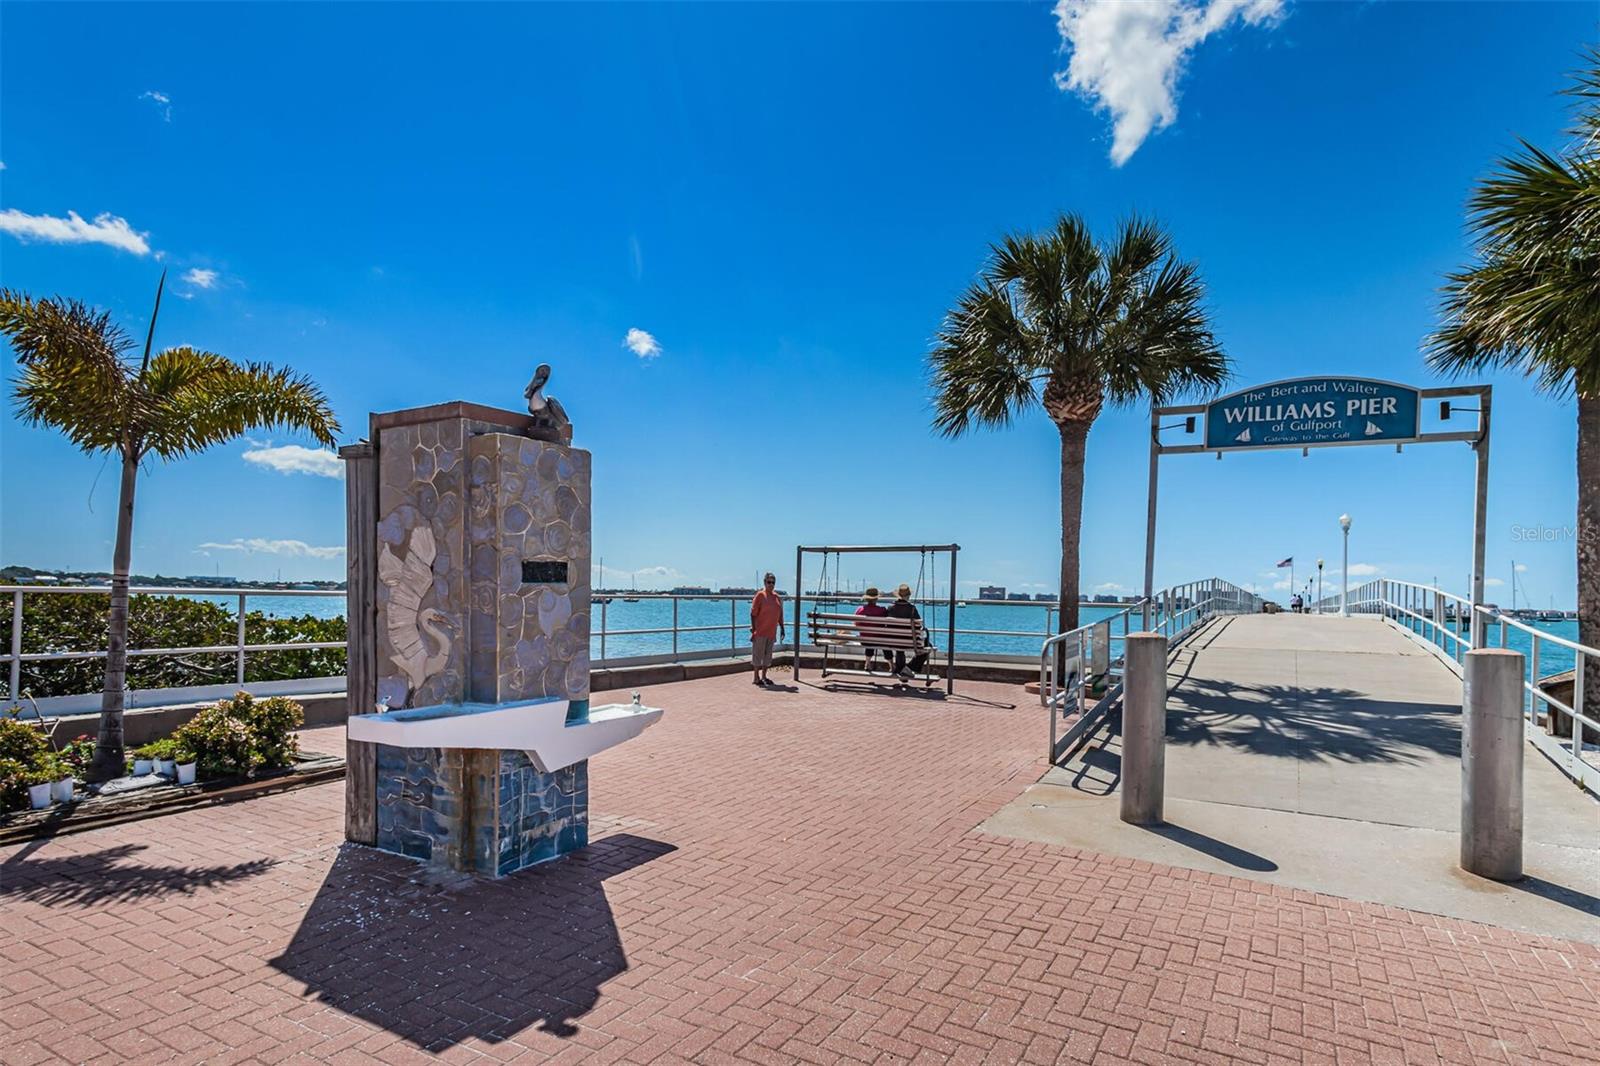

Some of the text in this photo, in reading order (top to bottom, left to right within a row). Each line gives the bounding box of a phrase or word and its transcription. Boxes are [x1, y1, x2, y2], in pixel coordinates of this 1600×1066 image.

[1244, 382, 1379, 403] The Bert and Walter
[1224, 397, 1397, 424] WILLIAMS PIER
[1272, 420, 1342, 432] of Gulfport
[1264, 435, 1298, 443] Gateway
[1316, 432, 1329, 440] the
